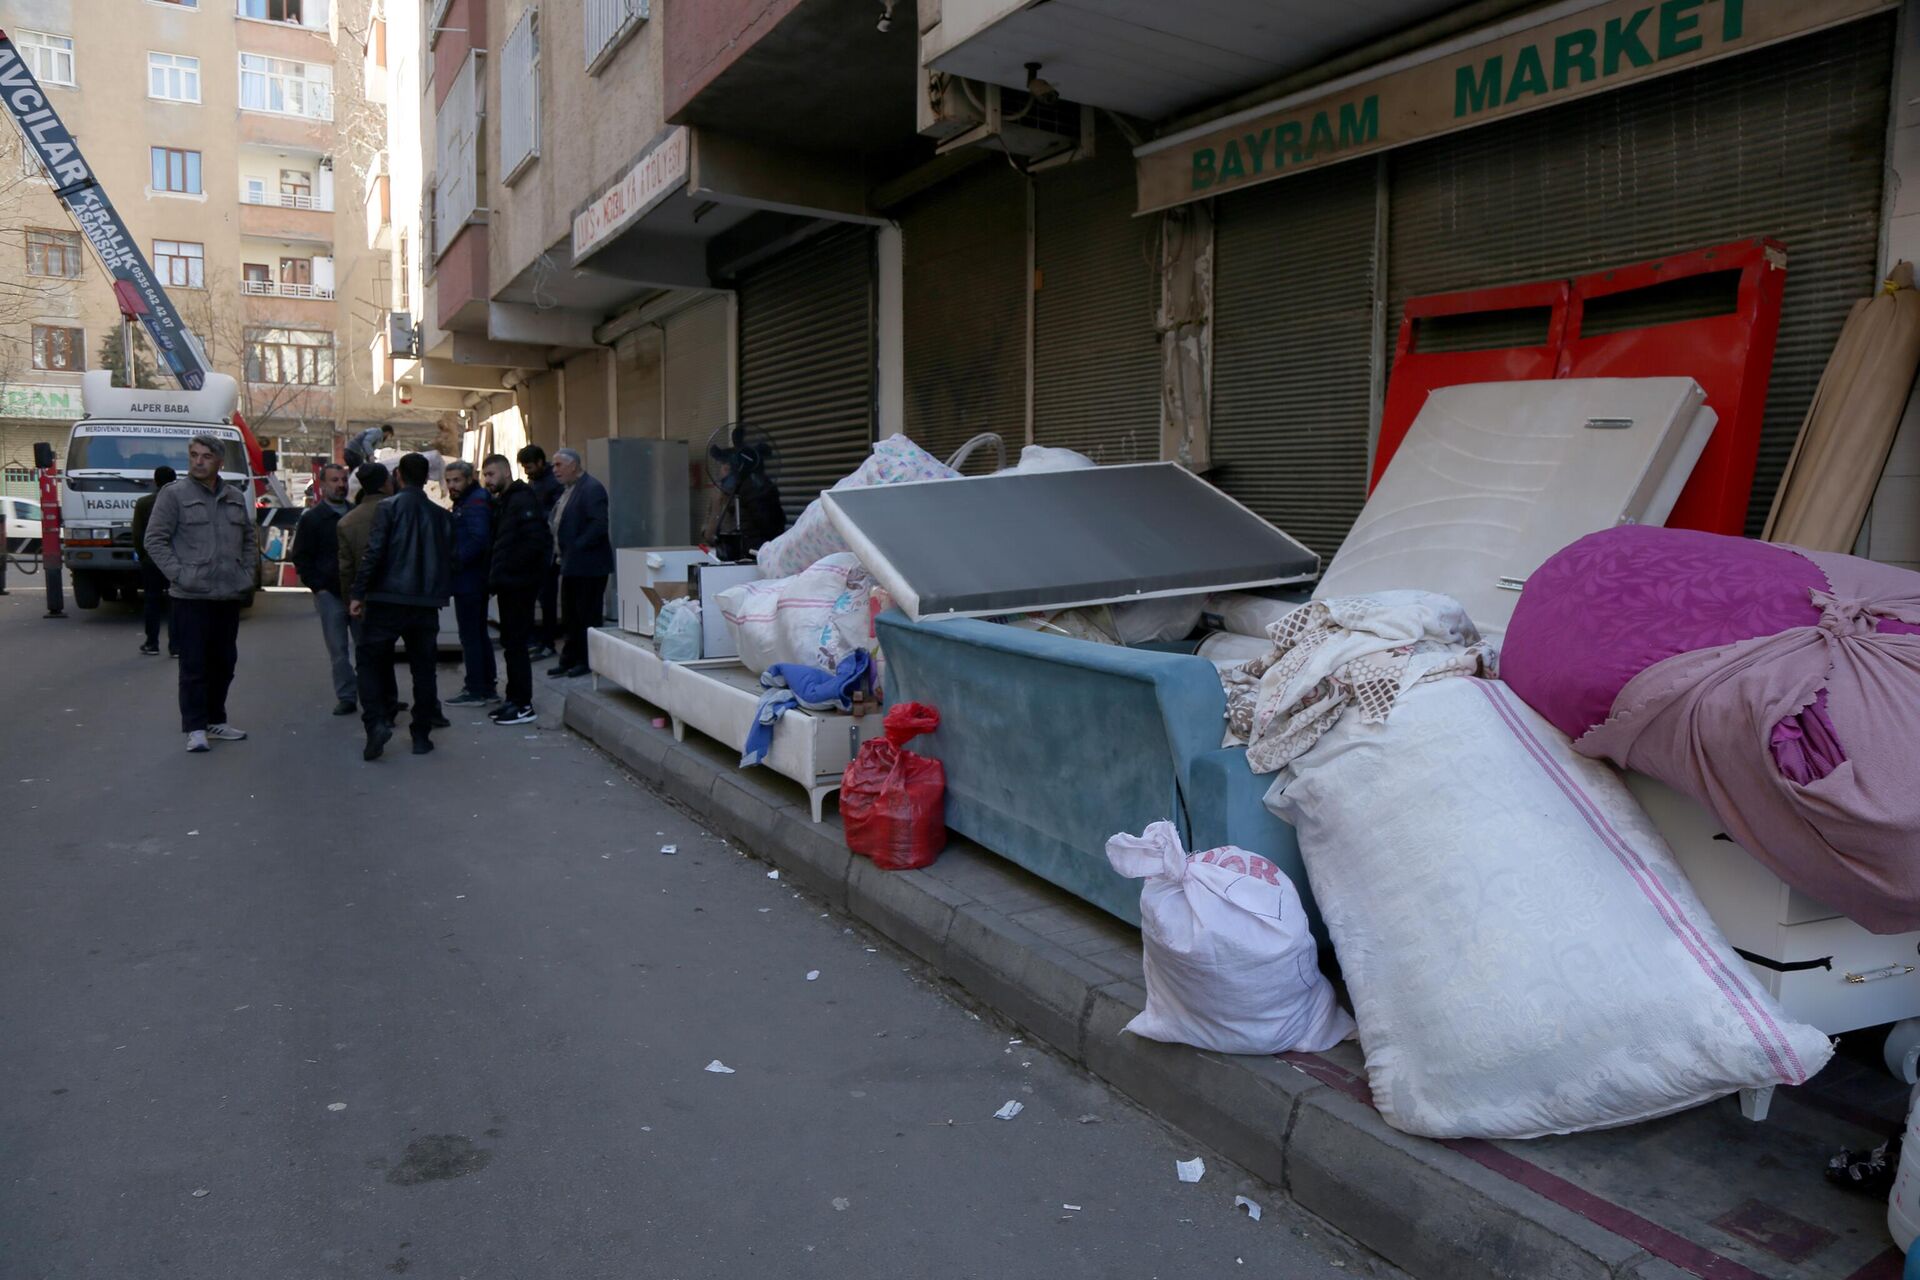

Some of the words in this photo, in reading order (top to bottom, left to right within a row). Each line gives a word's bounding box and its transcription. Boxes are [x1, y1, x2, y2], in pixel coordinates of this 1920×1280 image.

[0, 48, 88, 186] AVCILAR
[1190, 95, 1379, 190] BAYRAM
[1453, 0, 1744, 118] MARKET
[132, 267, 150, 289] 0535
[145, 288, 160, 306] 642
[155, 305, 168, 318] 42
[162, 317, 175, 328] 07
[130, 403, 161, 412] ALPER
[164, 404, 190, 414] BABA
